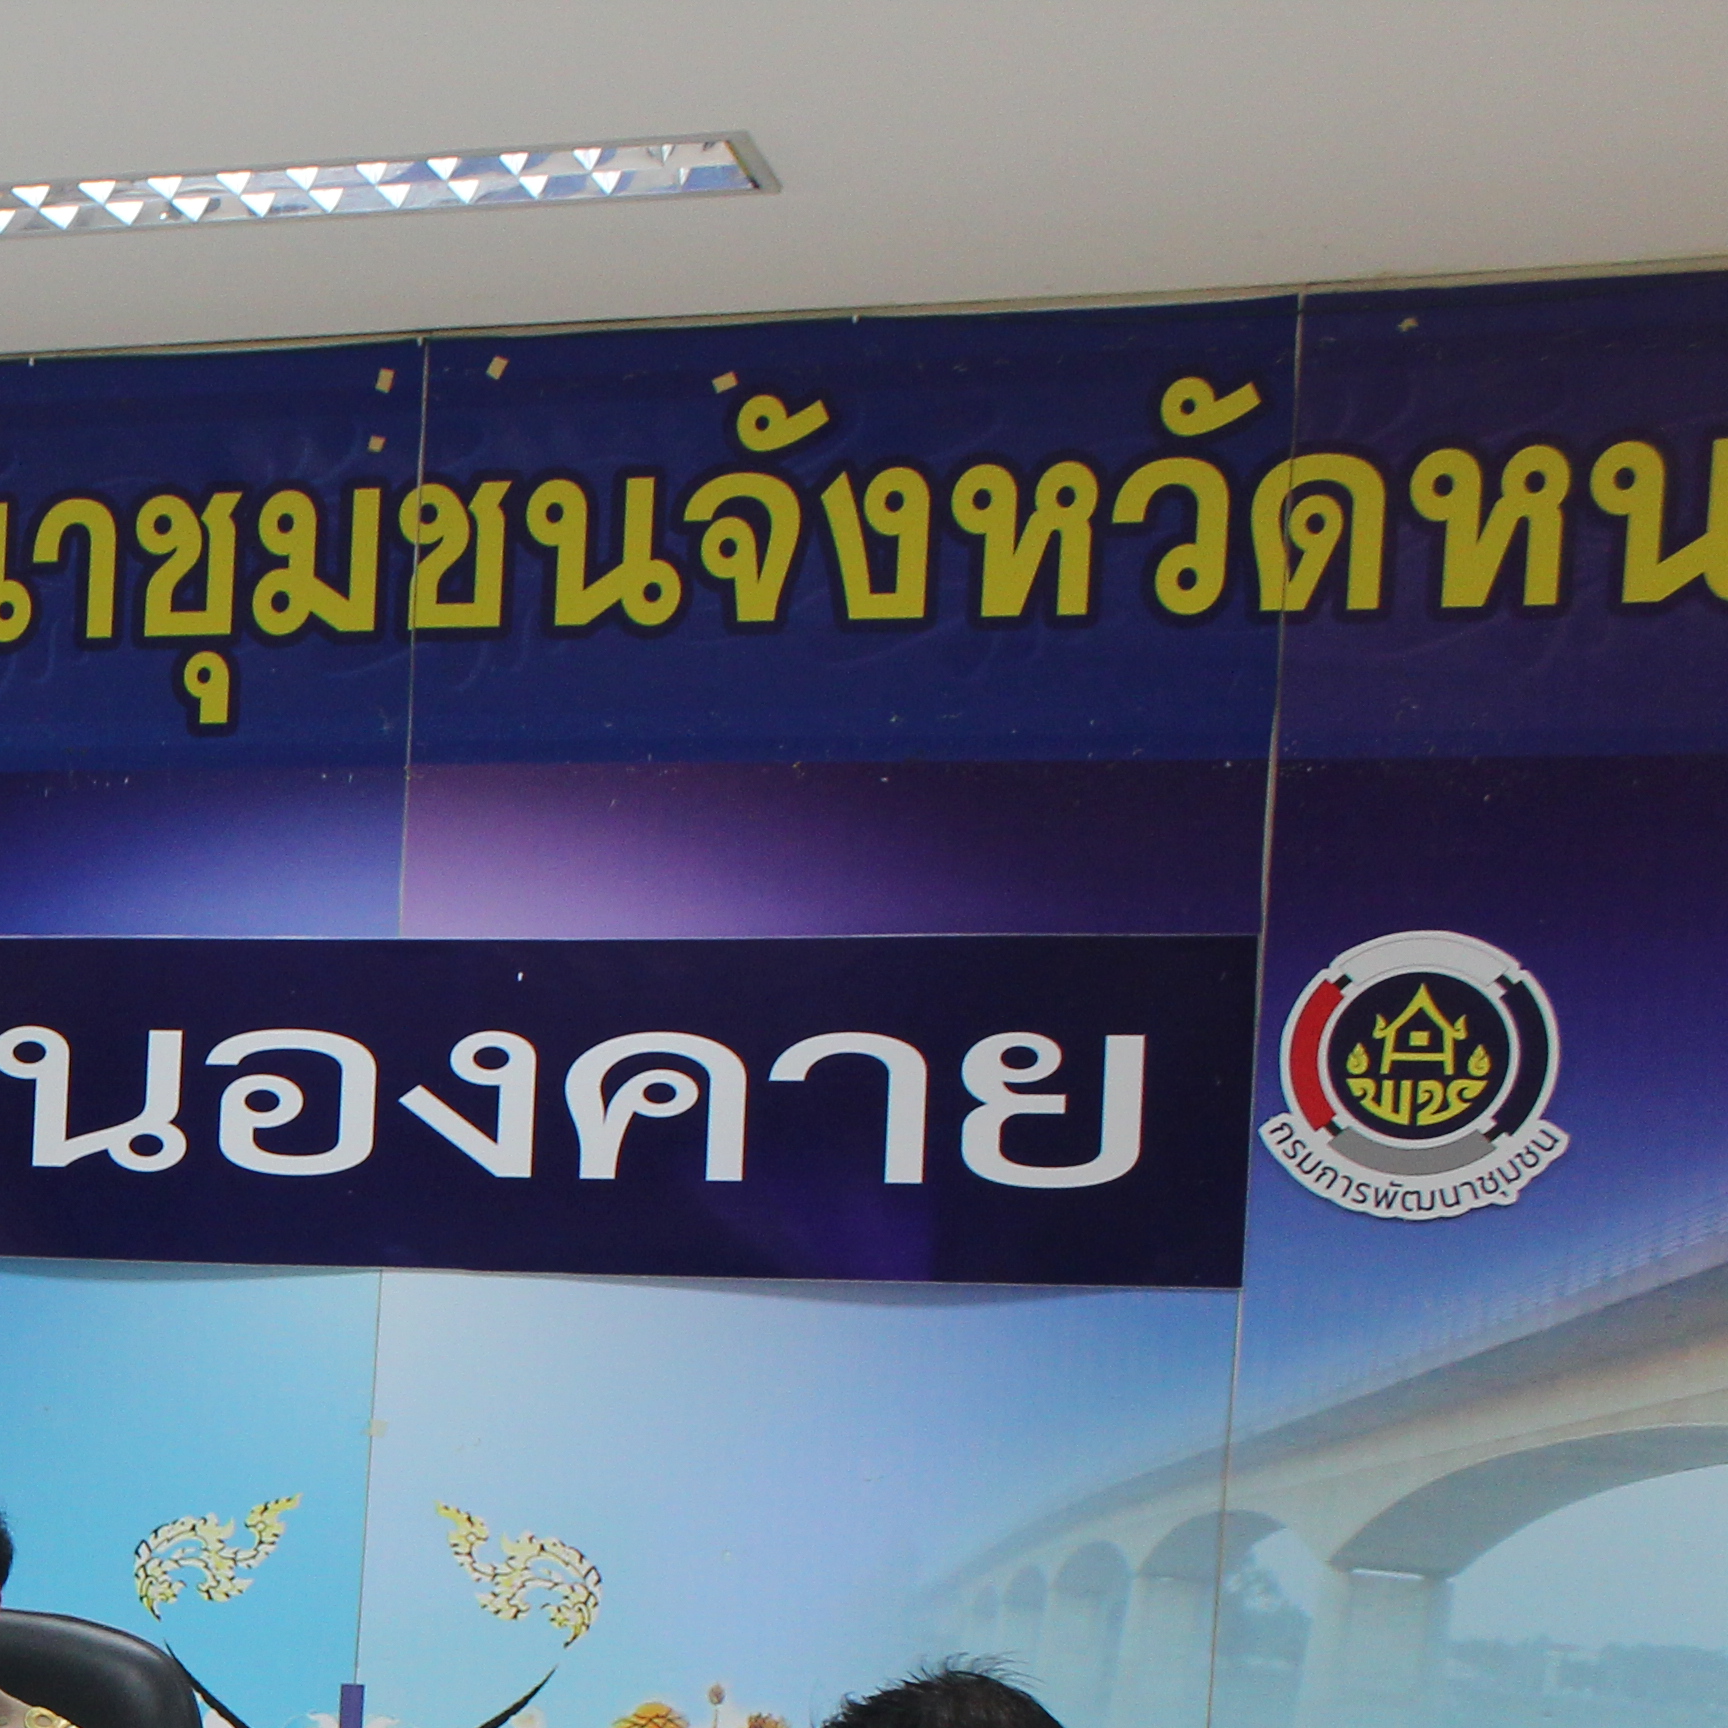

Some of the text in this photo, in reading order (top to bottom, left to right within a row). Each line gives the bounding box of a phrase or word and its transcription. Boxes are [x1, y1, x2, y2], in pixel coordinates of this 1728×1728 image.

[1268, 1118, 1560, 1213] กรมการพัฒนาชุมชน
